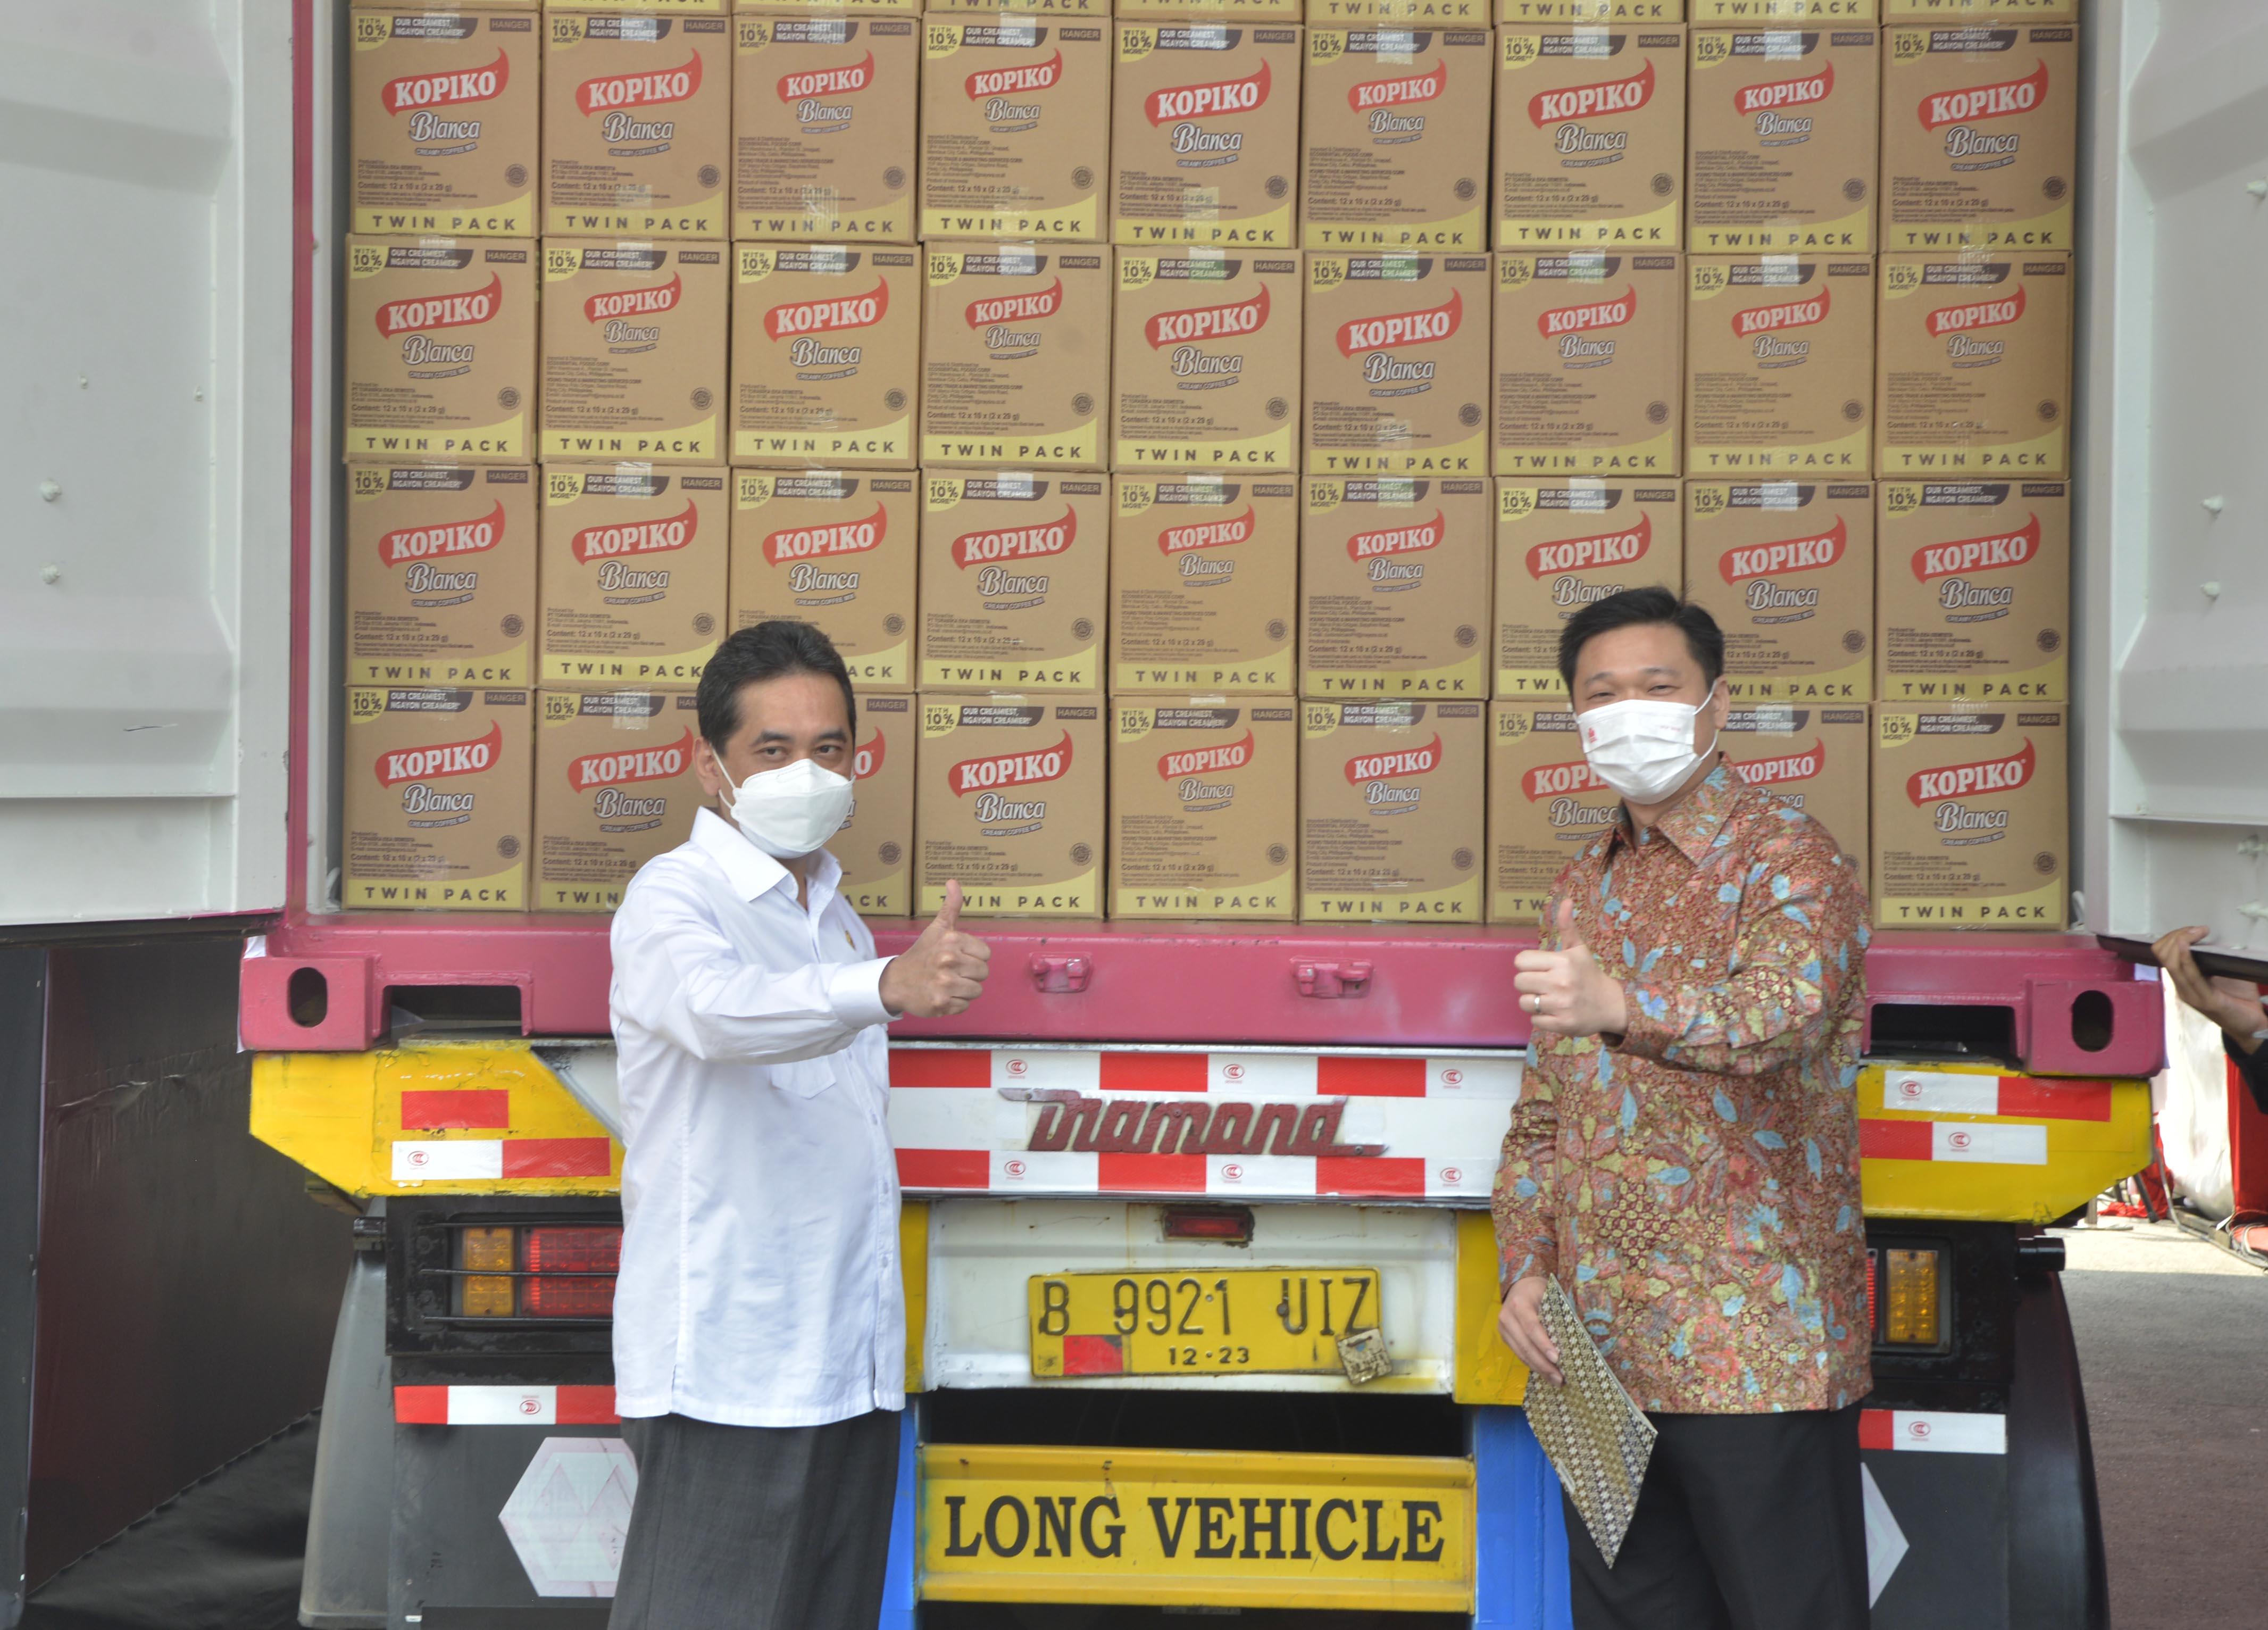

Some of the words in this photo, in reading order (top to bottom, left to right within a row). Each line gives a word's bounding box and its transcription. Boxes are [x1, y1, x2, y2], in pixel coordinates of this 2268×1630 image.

[929, 34, 957, 44] 10%
[395, 71, 496, 107] KOPIKO
[588, 72, 689, 108] KOPIKO
[786, 68, 864, 97] KOPIKO
[974, 66, 1053, 95] KOPIKO
[1357, 77, 1436, 107] KOPIKO
[1744, 80, 1823, 109] KOPIKO
[796, 99, 853, 122] Blanca
[985, 98, 1040, 121] Blanca
[1157, 82, 1258, 118] KOPIKO
[1541, 83, 1642, 119] KOPIKO
[1931, 84, 2034, 121] KOPIKO
[408, 111, 481, 140] Blanca
[603, 112, 674, 142] Blanca
[1369, 110, 1425, 133] Blanca
[1756, 111, 1812, 135] Blanca
[1171, 123, 1243, 152] Blanca
[1556, 123, 1626, 152] Blanca
[1946, 126, 2019, 155] Blanca
[373, 216, 435, 228] TWIN
[453, 218, 515, 230] PACK
[753, 221, 814, 231] TWIN
[831, 221, 893, 232] PACK
[1133, 228, 1195, 239] TWIN
[1212, 229, 1274, 242] PACK
[1519, 228, 1581, 239] TWIN
[1599, 228, 1661, 239] PACK
[1907, 233, 1970, 244] TWIN
[1989, 232, 2052, 244] PACK
[354, 254, 381, 265] 10%
[1123, 266, 1151, 277] 10%
[388, 295, 489, 330] KOPIKO
[594, 289, 671, 318] KOPIKO
[777, 298, 875, 333] KOPIKO
[974, 295, 1052, 323] KOPIKO
[1547, 303, 1626, 332] KOPIKO
[1741, 303, 1820, 331] KOPIKO
[1935, 302, 2015, 331] KOPIKO
[604, 320, 660, 343] Blanca
[985, 327, 1040, 348] Blanca
[1158, 306, 1257, 340] KOPIKO
[1348, 312, 1449, 348] KOPIKO
[403, 335, 474, 364] Blanca
[791, 337, 861, 366] Blanca
[1559, 334, 1615, 357] Blanca
[1753, 335, 1810, 357] Blanca
[1947, 335, 2004, 357] Blanca
[1172, 346, 1242, 375] Blanca
[1364, 352, 1435, 381] Blanca
[561, 439, 622, 450] TWIN
[639, 441, 701, 452] PACK
[942, 445, 1003, 455] TWIN
[1020, 446, 1081, 457] PACK
[1711, 454, 1771, 464] TWIN
[1789, 454, 1852, 464] PACK
[1328, 458, 1389, 469] TWIN
[1406, 458, 1468, 470] PACK
[1503, 496, 1531, 508] 10%
[391, 523, 492, 559] KOPIKO
[584, 521, 685, 556] KOPIKO
[775, 524, 874, 558] KOPIKO
[964, 527, 1063, 561] KOPIKO
[1167, 522, 1245, 550] KOPIKO
[1356, 527, 1434, 556] KOPIKO
[1179, 554, 1234, 576] Blanca
[1538, 535, 1639, 571] KOPIKO
[1732, 539, 1833, 576] KOPIKO
[1924, 537, 2027, 573] KOPIKO
[406, 563, 477, 592] Blanca
[598, 561, 670, 590] Blanca
[789, 563, 859, 591] Blanca
[978, 566, 1048, 595] Blanca
[1368, 558, 1424, 581] Blanca
[1747, 579, 1818, 609] Blanca
[1940, 578, 2013, 607] Blanca
[369, 667, 431, 679] TWIN
[448, 668, 511, 680] PACK
[941, 669, 1002, 680] TWIN
[1020, 671, 1080, 683] PACK
[1137, 671, 1197, 681] TWIN
[1214, 672, 1275, 683] PACK
[1324, 679, 1385, 689] TWIN
[1403, 679, 1464, 690] PACK
[1903, 684, 1965, 695] TWIN
[1984, 684, 2047, 695] PACK
[1882, 722, 1912, 733] 10%
[388, 744, 489, 779] KOPIKO
[580, 749, 681, 784] KOPIKO
[961, 753, 1060, 788] KOPIKO
[1167, 746, 1244, 775] KOPIKO
[1354, 751, 1431, 779] KOPIKO
[1179, 778, 1234, 801] Blanca
[1365, 781, 1420, 804] Blanca
[1919, 762, 2022, 798] KOPIKO
[403, 784, 474, 813] Blanca
[595, 788, 666, 817] Blanca
[975, 793, 1045, 821] Blanca
[1935, 802, 2008, 830] Blanca
[365, 887, 427, 899] TWIN
[445, 889, 506, 901] PACK
[1322, 902, 1383, 912] TWIN
[1400, 902, 1462, 913] PACK
[1900, 907, 1963, 918] TWIN
[1981, 907, 2045, 918] PACK
[1039, 1279, 1069, 1335] B
[1113, 1278, 1231, 1336] 9921
[1278, 1277, 1370, 1336] UIZ
[944, 1495, 1126, 1559] LONG
[1147, 1498, 1445, 1562] VEHICLE
